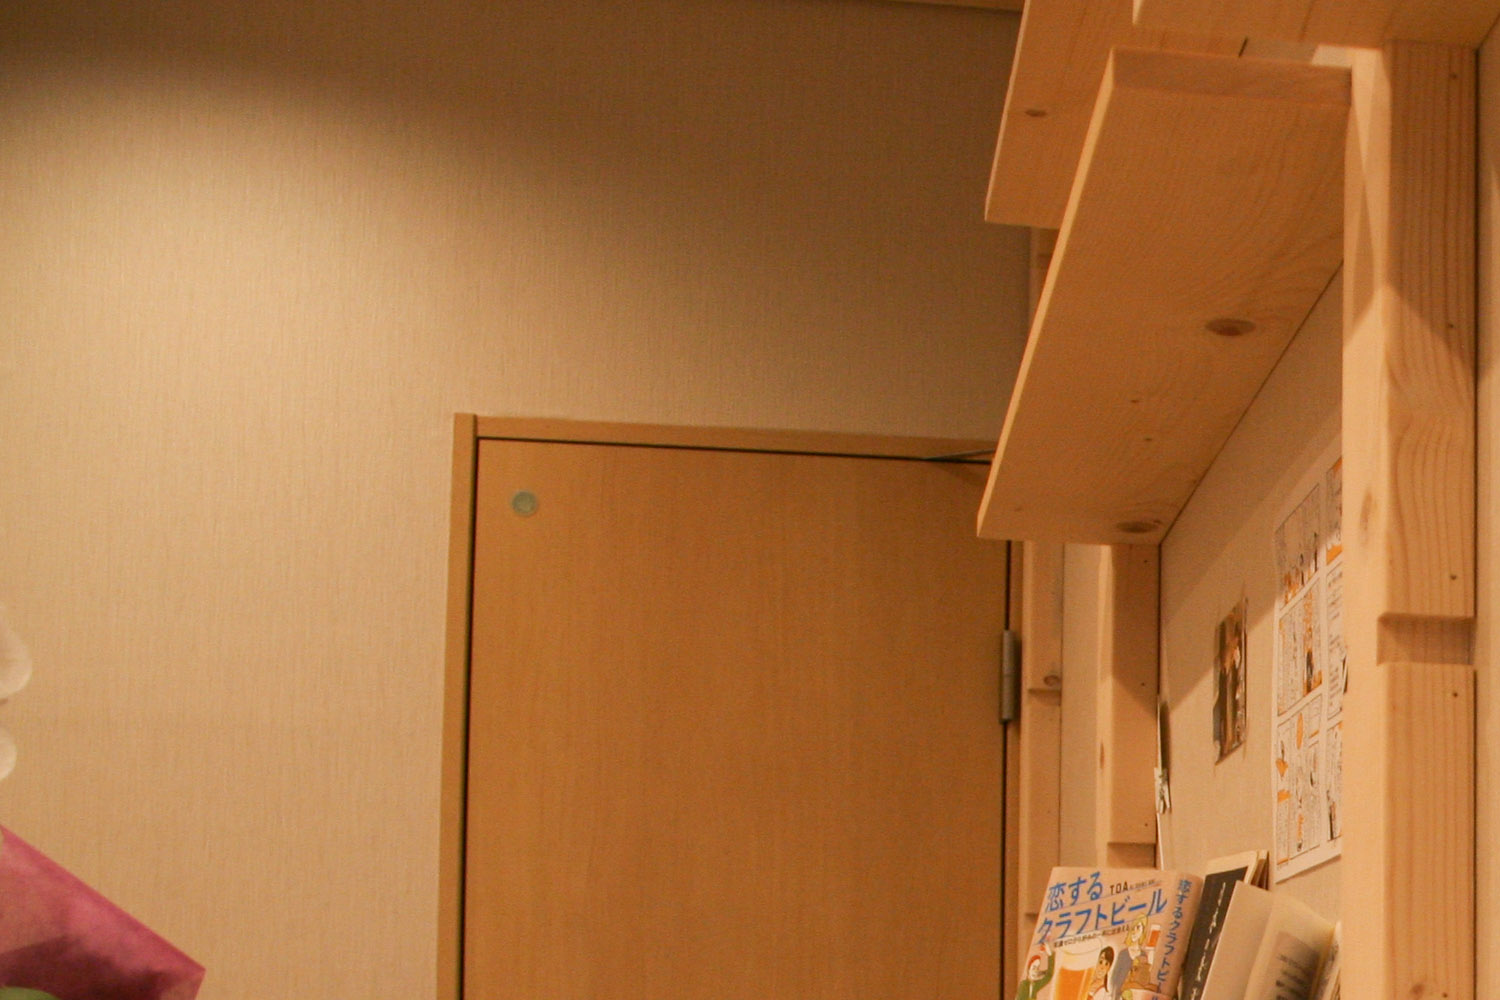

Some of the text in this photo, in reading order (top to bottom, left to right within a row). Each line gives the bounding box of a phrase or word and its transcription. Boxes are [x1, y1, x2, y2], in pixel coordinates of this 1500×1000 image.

[1045, 871, 1104, 914] 恋する
[1109, 881, 1129, 895] TOA
[1036, 888, 1168, 945] クラフトビール
